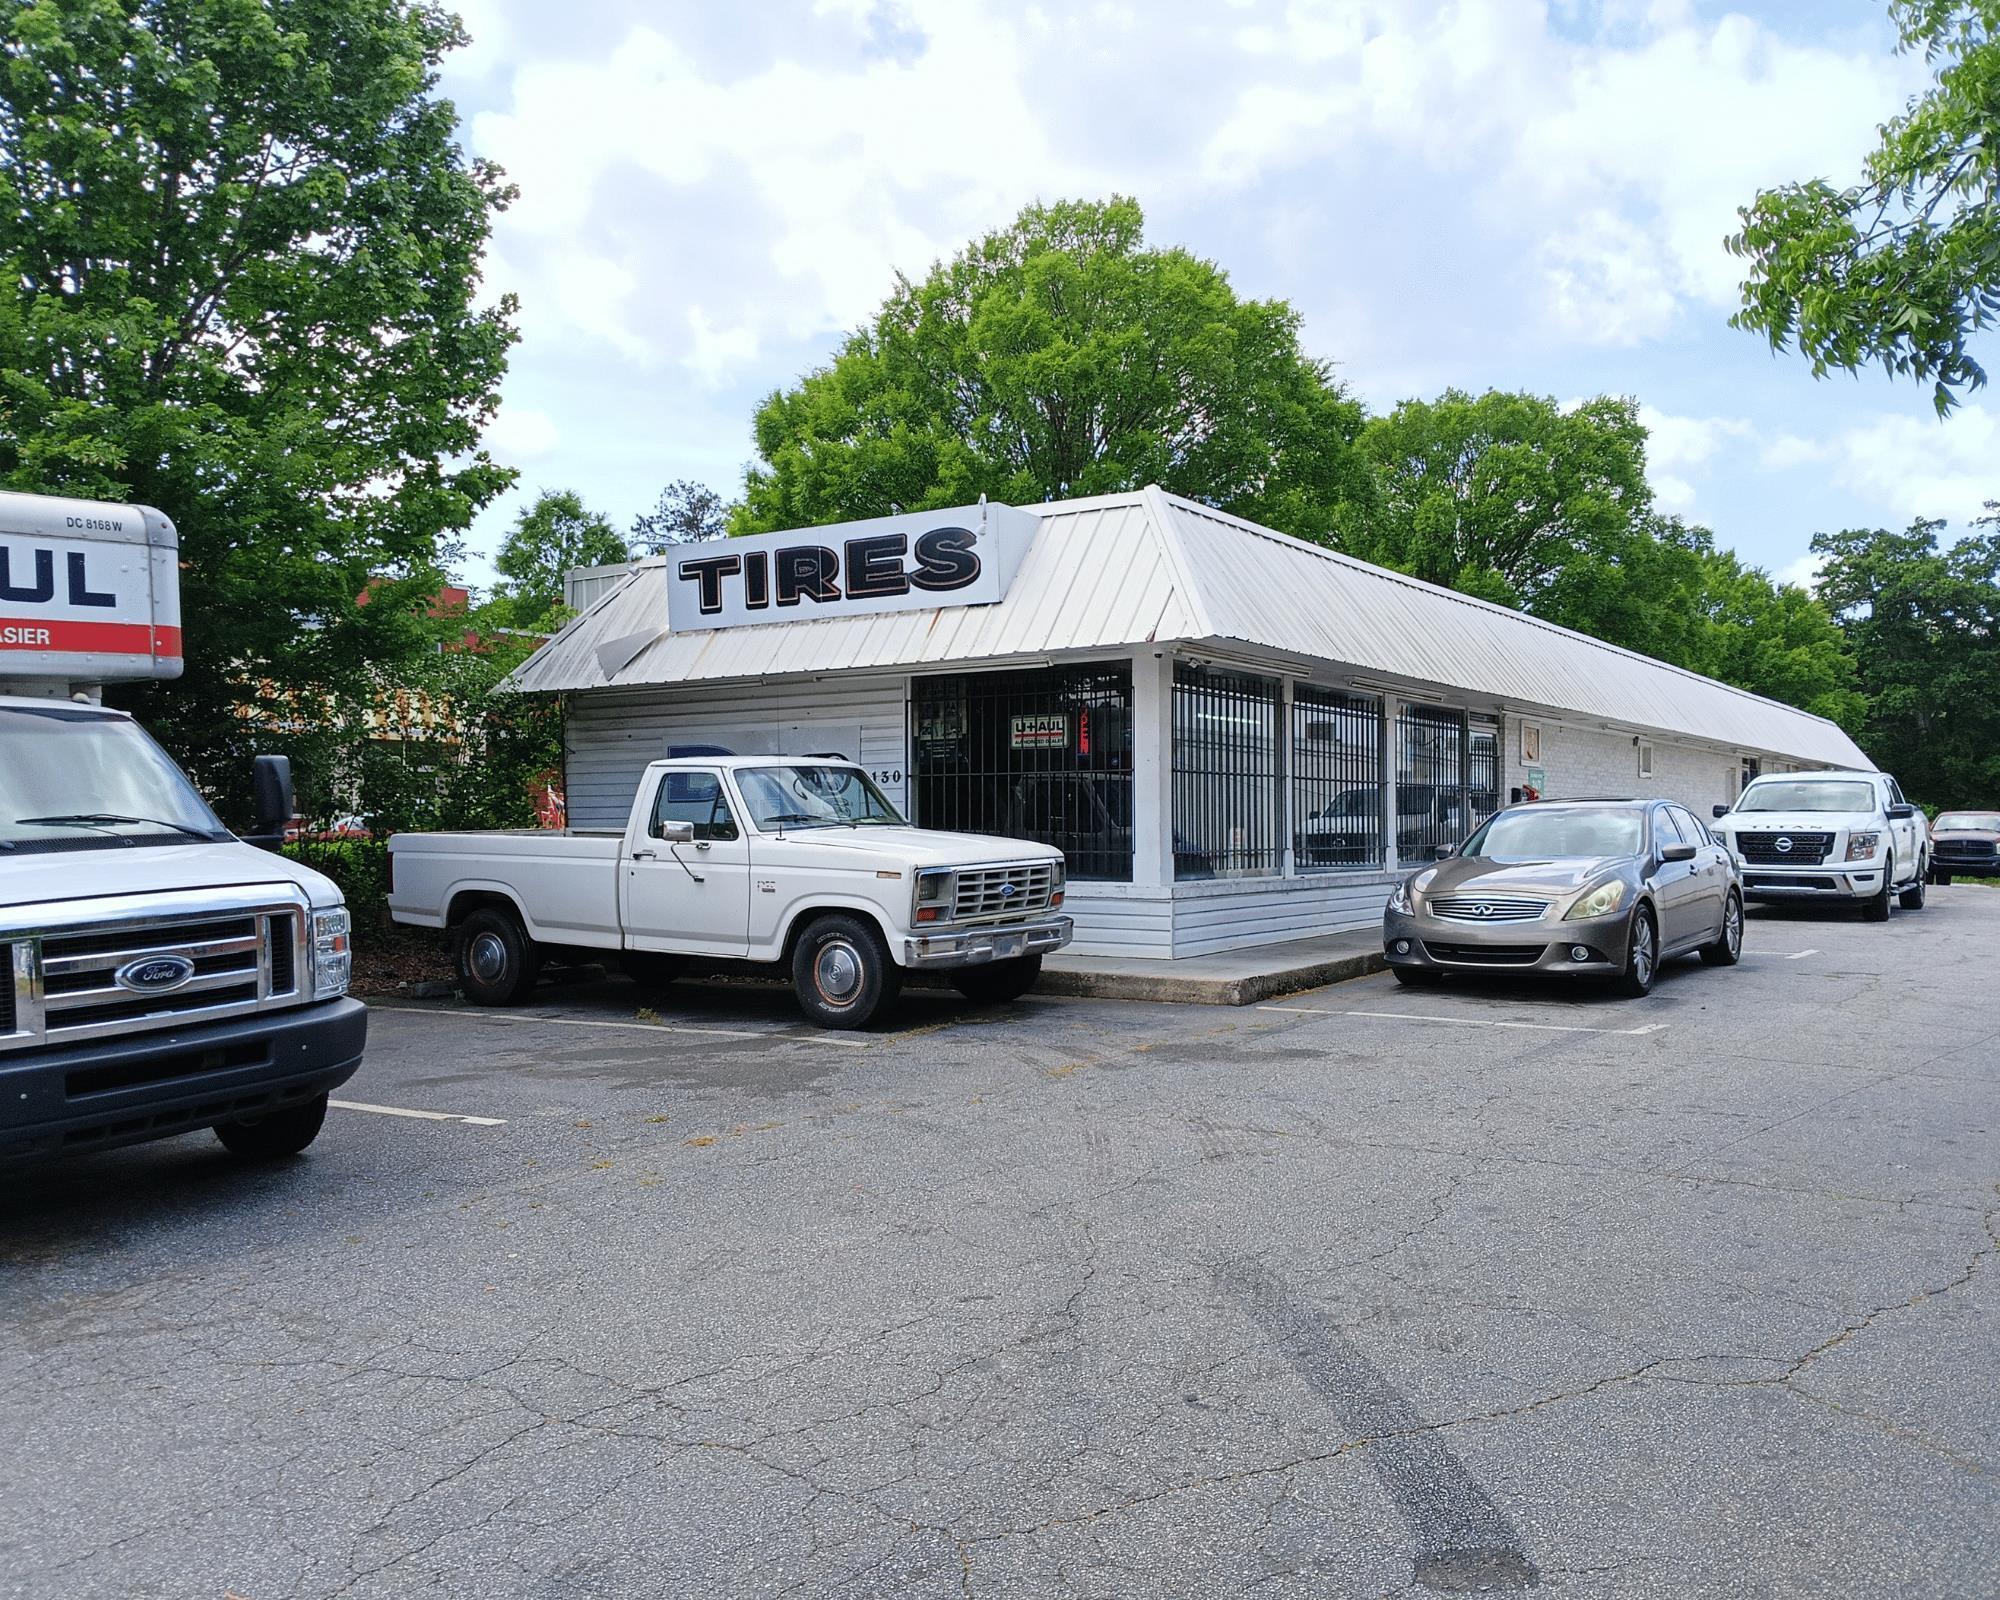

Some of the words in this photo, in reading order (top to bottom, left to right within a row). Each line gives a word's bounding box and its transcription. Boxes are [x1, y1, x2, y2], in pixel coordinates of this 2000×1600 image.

[66, 517, 83, 528] DC
[678, 526, 982, 615] TIRES
[0, 627, 50, 645] SIER
[872, 770, 901, 784] 130
[143, 964, 176, 981] Ford
